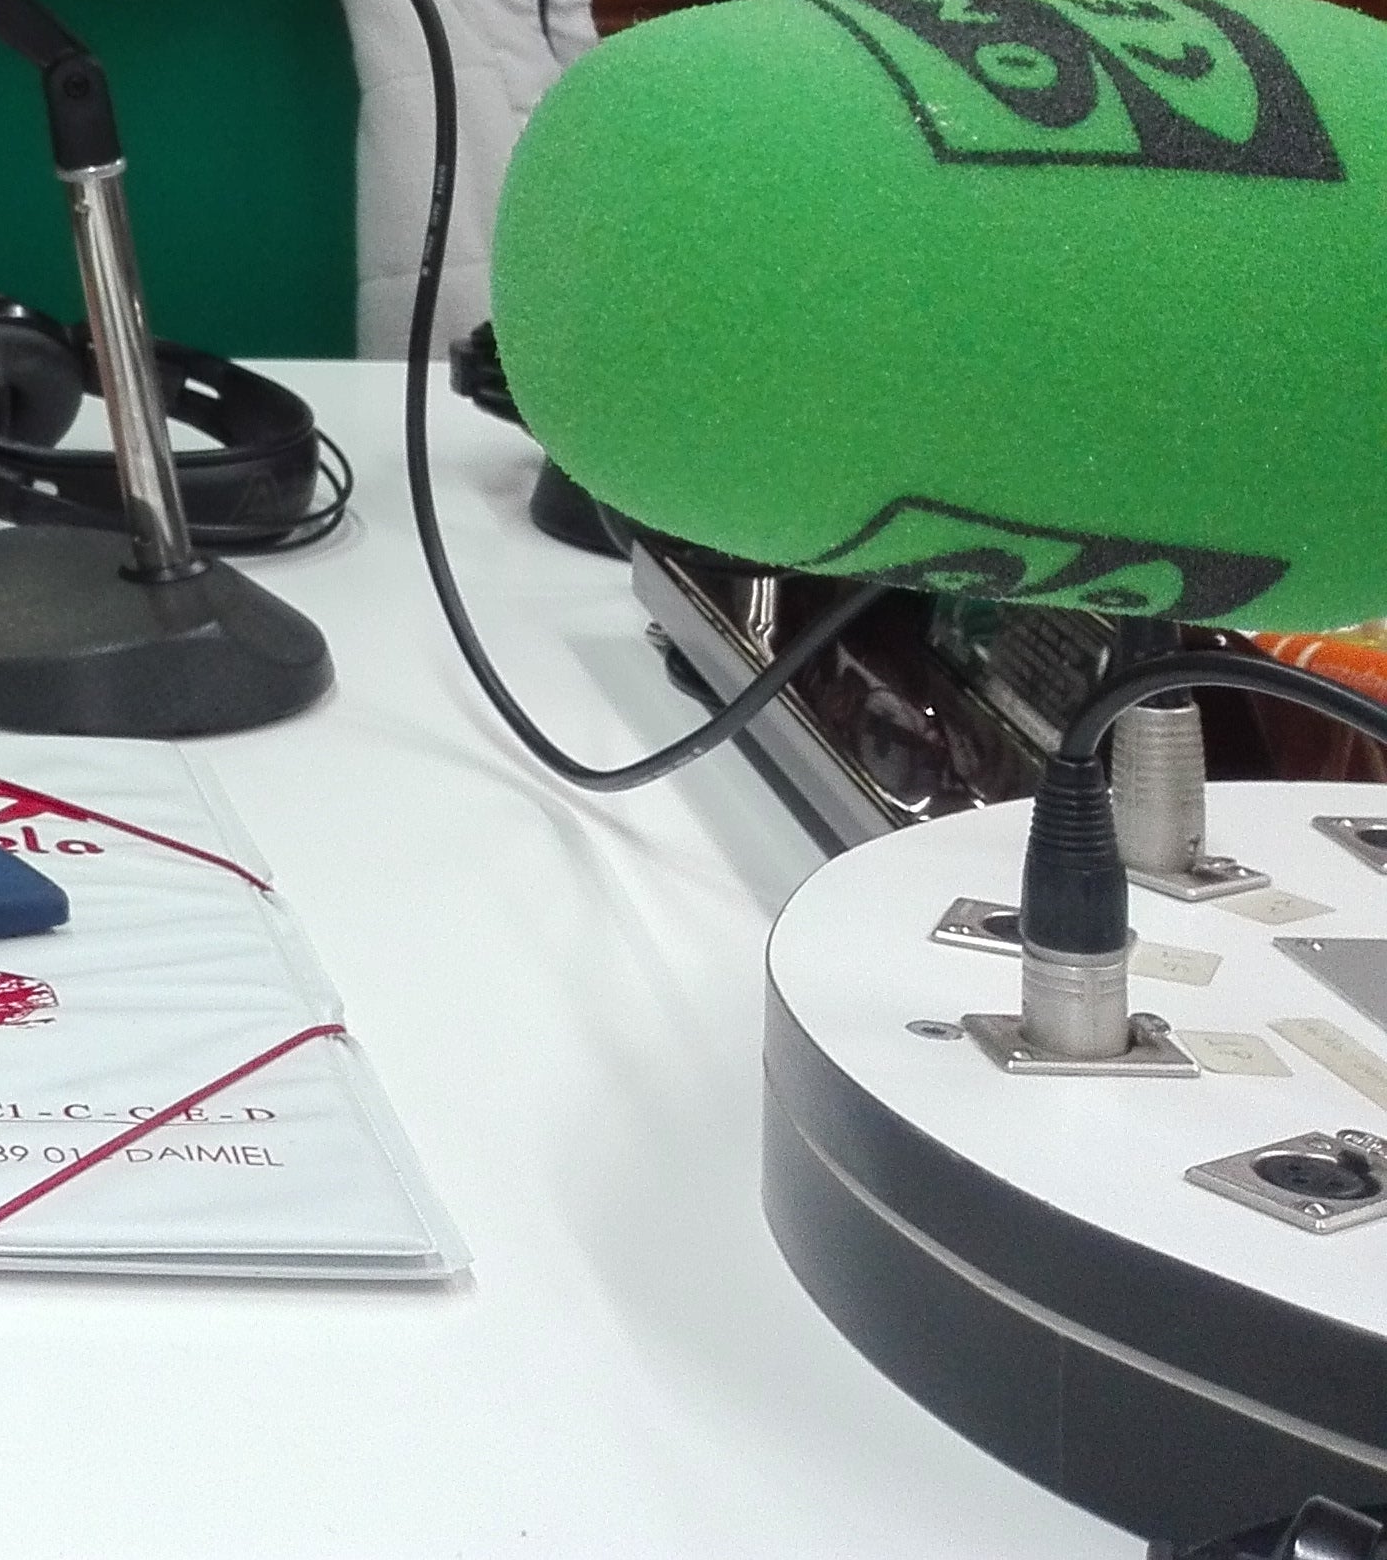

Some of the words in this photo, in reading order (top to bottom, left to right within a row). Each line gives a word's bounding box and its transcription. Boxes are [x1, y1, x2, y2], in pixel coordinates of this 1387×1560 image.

[63, 1103, 93, 1120] C
[243, 1107, 277, 1122] D
[125, 1145, 285, 1167] DAIMIEL
